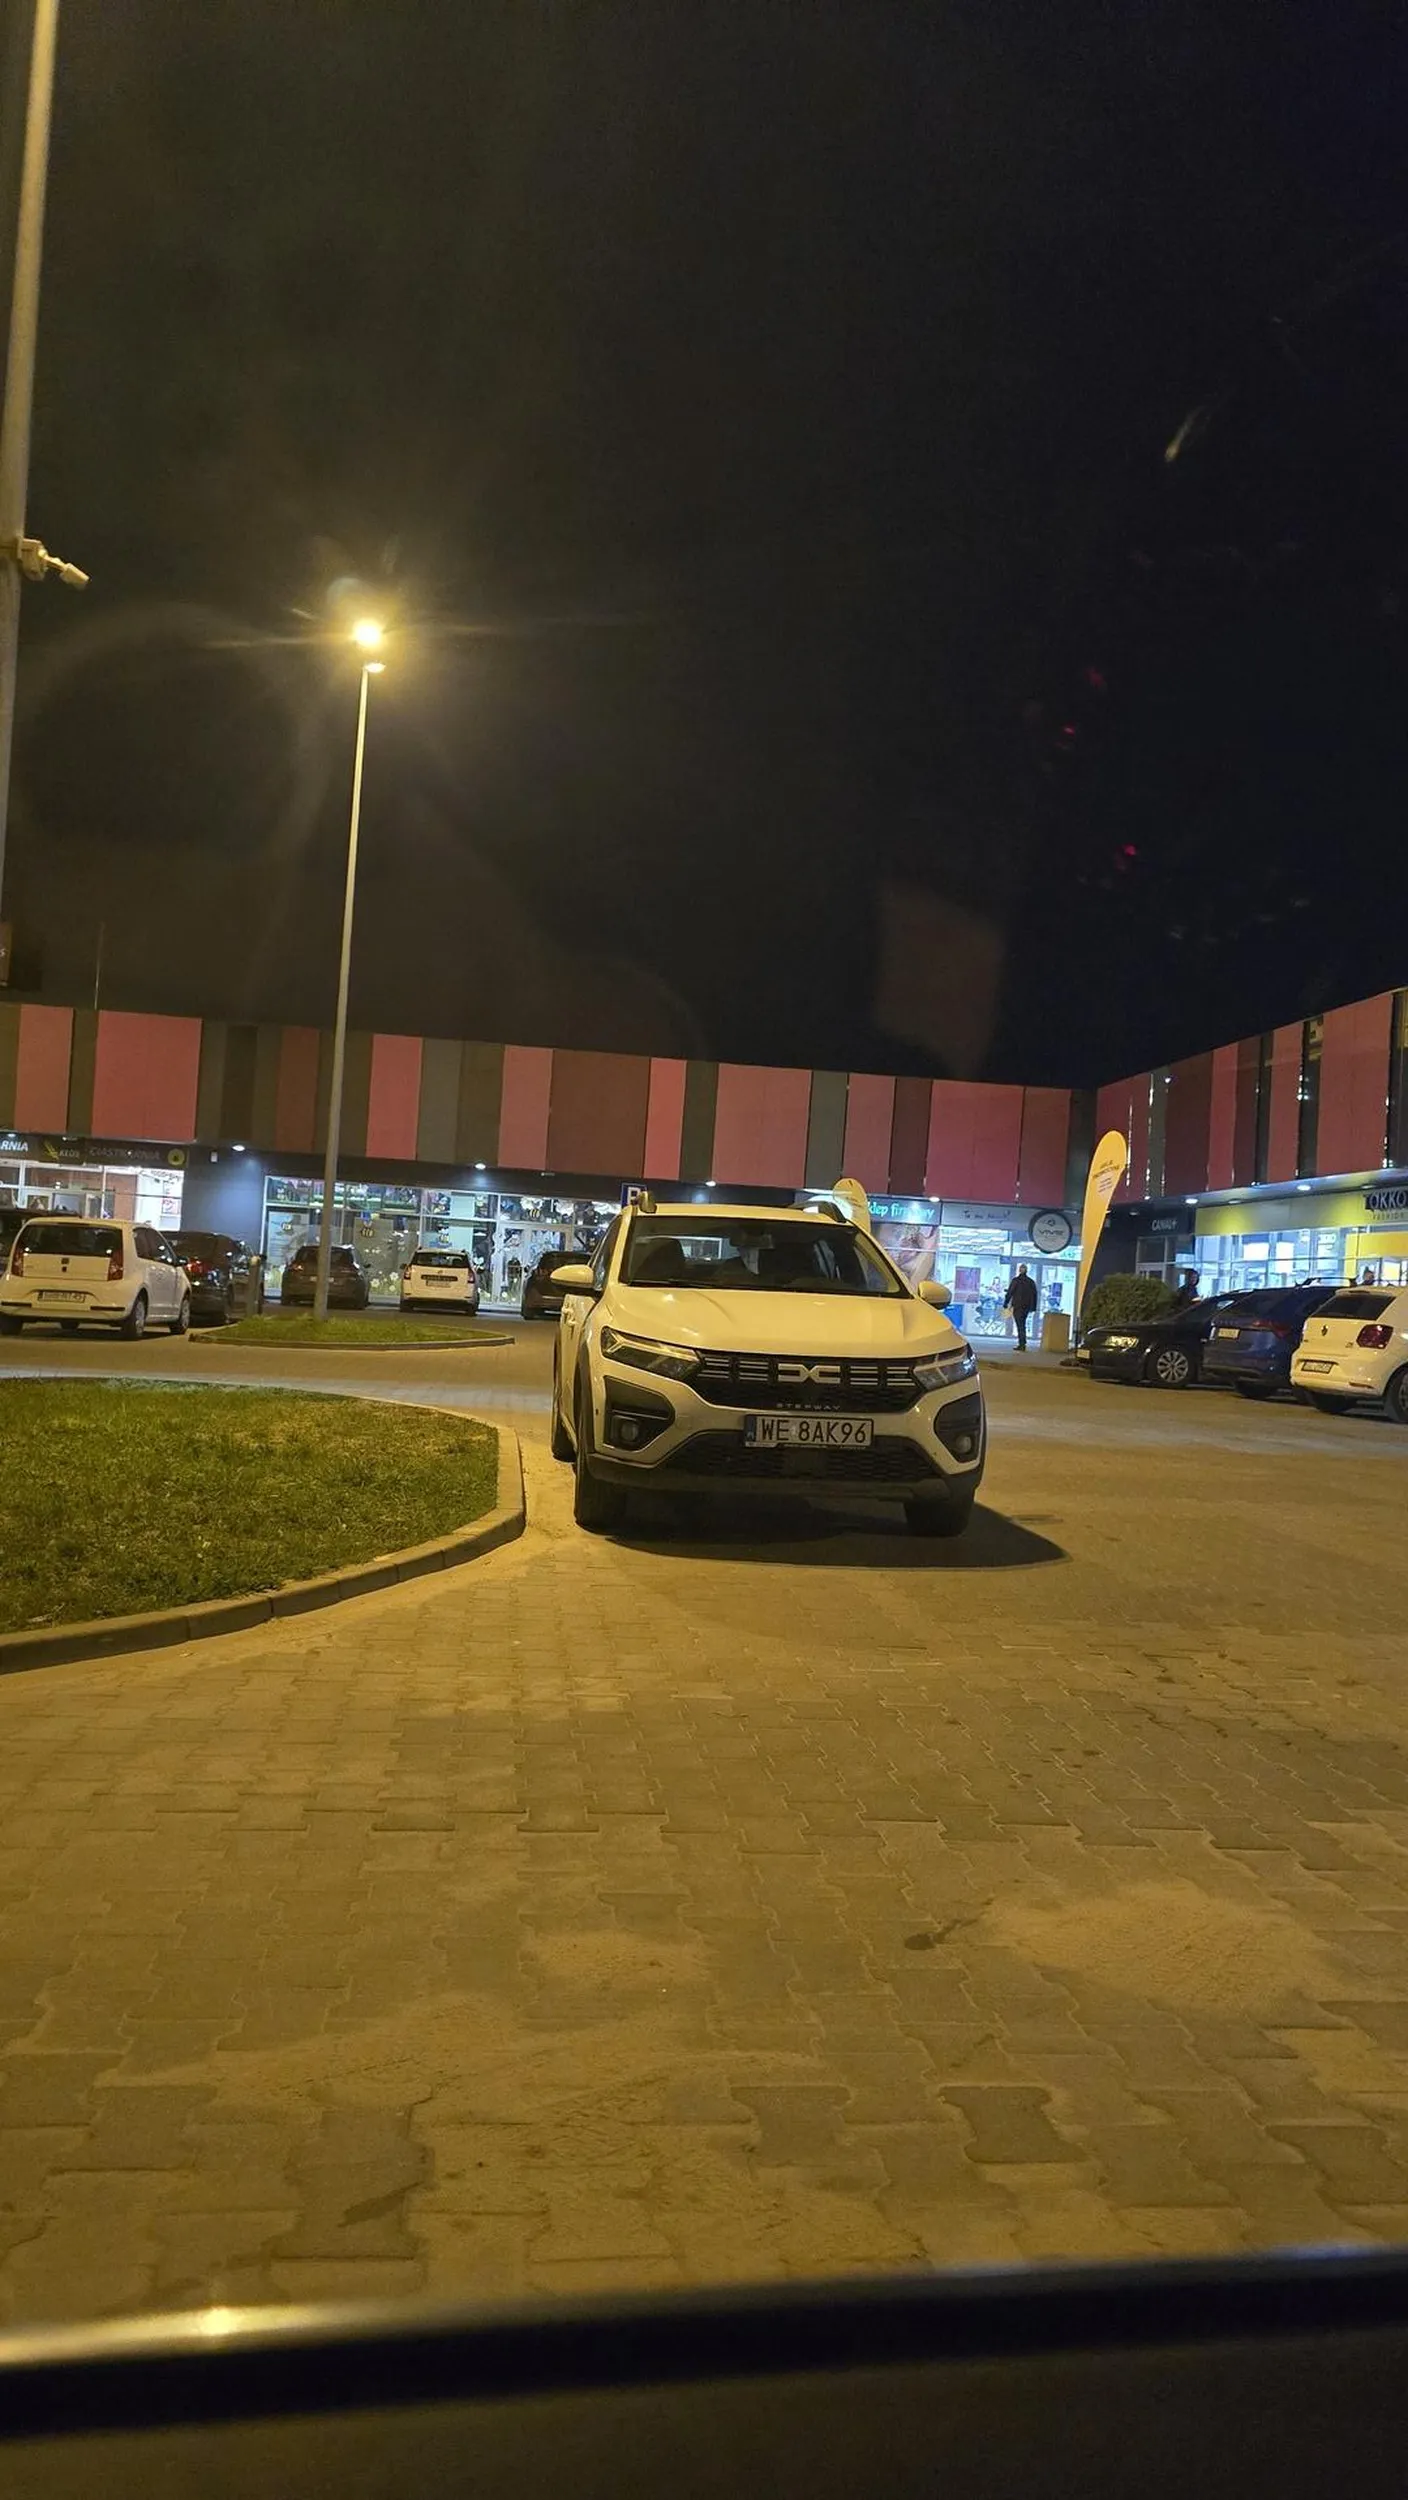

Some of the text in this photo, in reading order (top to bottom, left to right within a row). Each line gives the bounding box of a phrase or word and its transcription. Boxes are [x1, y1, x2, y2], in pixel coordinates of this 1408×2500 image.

[0, 1139, 29, 1152] RNIA
[1369, 1189, 1407, 1209] OKKO
[761, 1418, 867, 1444] WE 8AK96
